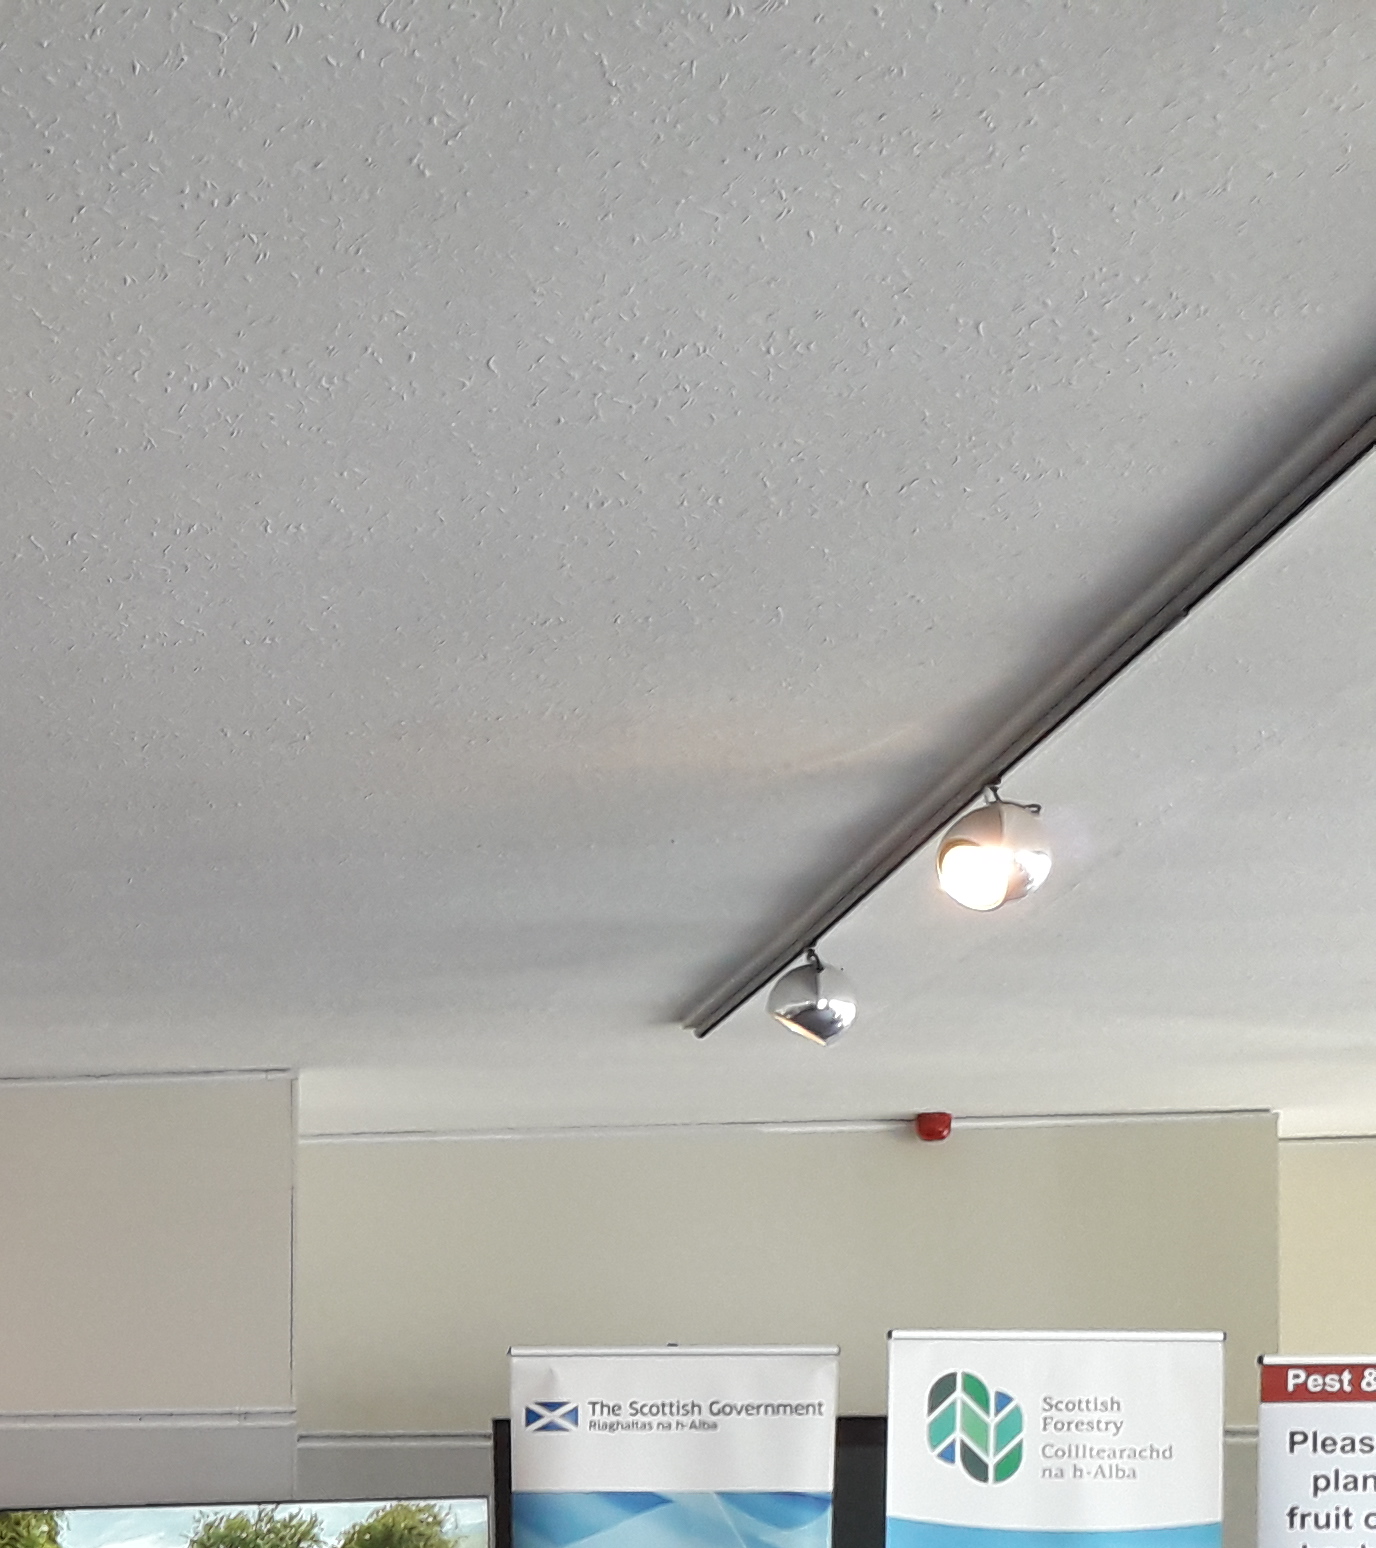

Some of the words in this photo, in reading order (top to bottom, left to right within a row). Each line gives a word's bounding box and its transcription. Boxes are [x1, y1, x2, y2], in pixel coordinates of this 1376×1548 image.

[1286, 1367, 1353, 1393] Pest
[587, 1399, 622, 1417] The
[629, 1399, 702, 1418] Scottish
[708, 1400, 824, 1418] Government
[1042, 1396, 1121, 1413] Scottish
[1042, 1416, 1124, 1437] Forestry
[1041, 1443, 1173, 1460] Coilltearachd
[1041, 1467, 1064, 1479] na
[1285, 1505, 1353, 1531] fruit
